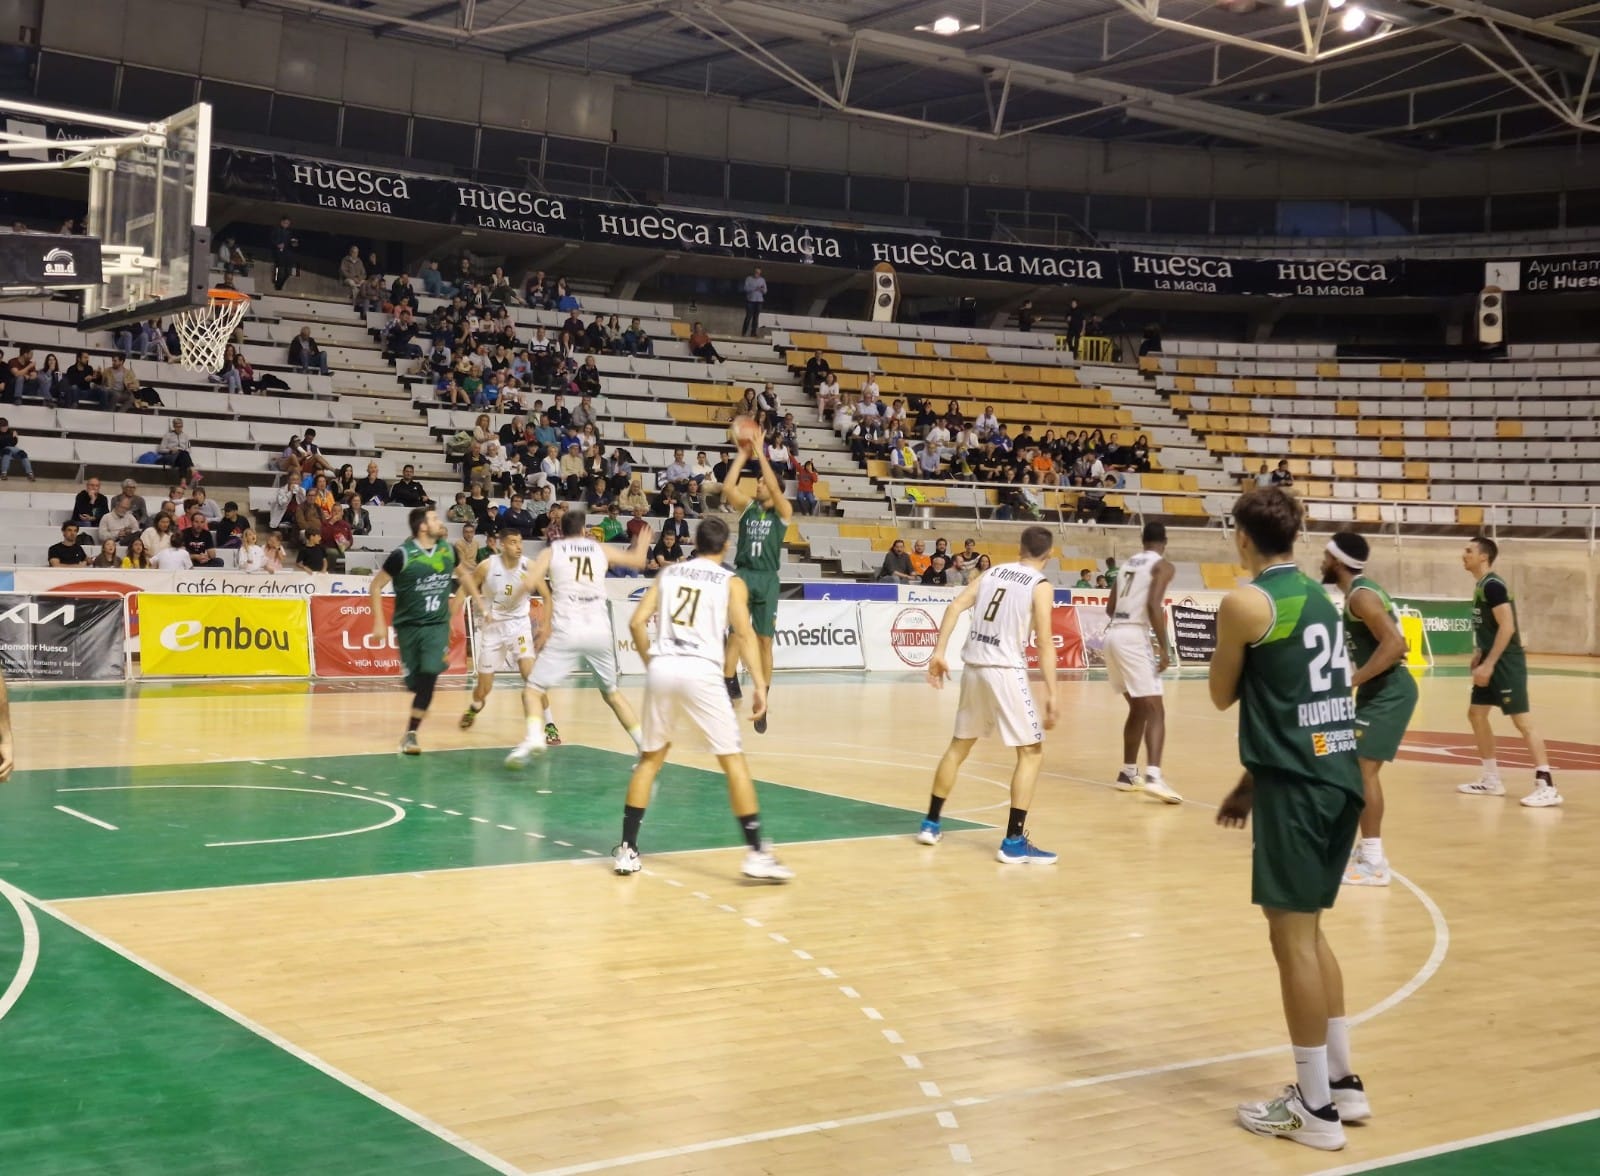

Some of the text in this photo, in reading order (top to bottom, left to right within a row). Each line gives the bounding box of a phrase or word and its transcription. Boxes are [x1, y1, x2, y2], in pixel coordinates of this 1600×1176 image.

[291, 164, 411, 199] Huesca
[458, 187, 566, 220] Huesca
[599, 213, 711, 245] Huesca
[872, 242, 976, 270] Huesca
[1133, 254, 1233, 279] Huesca
[1278, 260, 1388, 282] Huesca
[1528, 277, 1549, 291] de
[751, 541, 763, 557] 11
[569, 556, 594, 582] 74
[176, 578, 217, 593] café
[222, 580, 256, 593] bar
[505, 584, 513, 596] 51
[340, 606, 371, 615] GRUPO
[425, 596, 440, 612] 16
[673, 586, 701, 627] 21
[984, 588, 1006, 622] 8
[160, 616, 290, 652] embou
[39, 643, 68, 653] Huesca
[1302, 620, 1352, 692] 24
